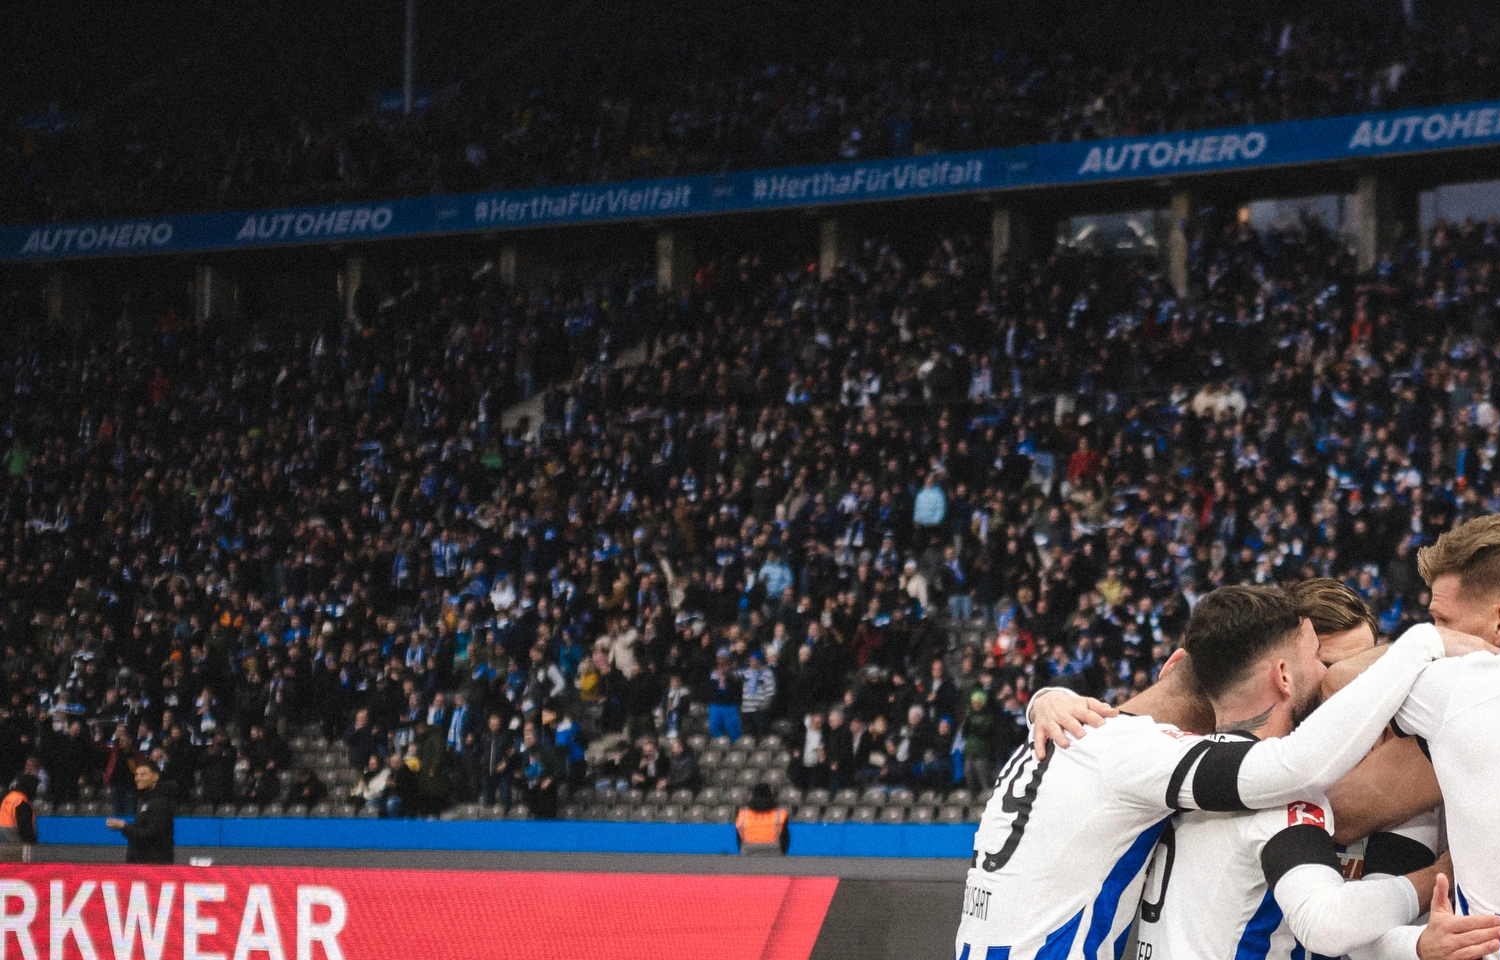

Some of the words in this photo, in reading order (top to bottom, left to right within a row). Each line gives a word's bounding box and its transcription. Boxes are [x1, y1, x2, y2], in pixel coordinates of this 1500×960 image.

[1078, 132, 1268, 175] AUTOHERO
[21, 222, 174, 255] AUTOHERO
[236, 207, 393, 242] AUTOHERO
